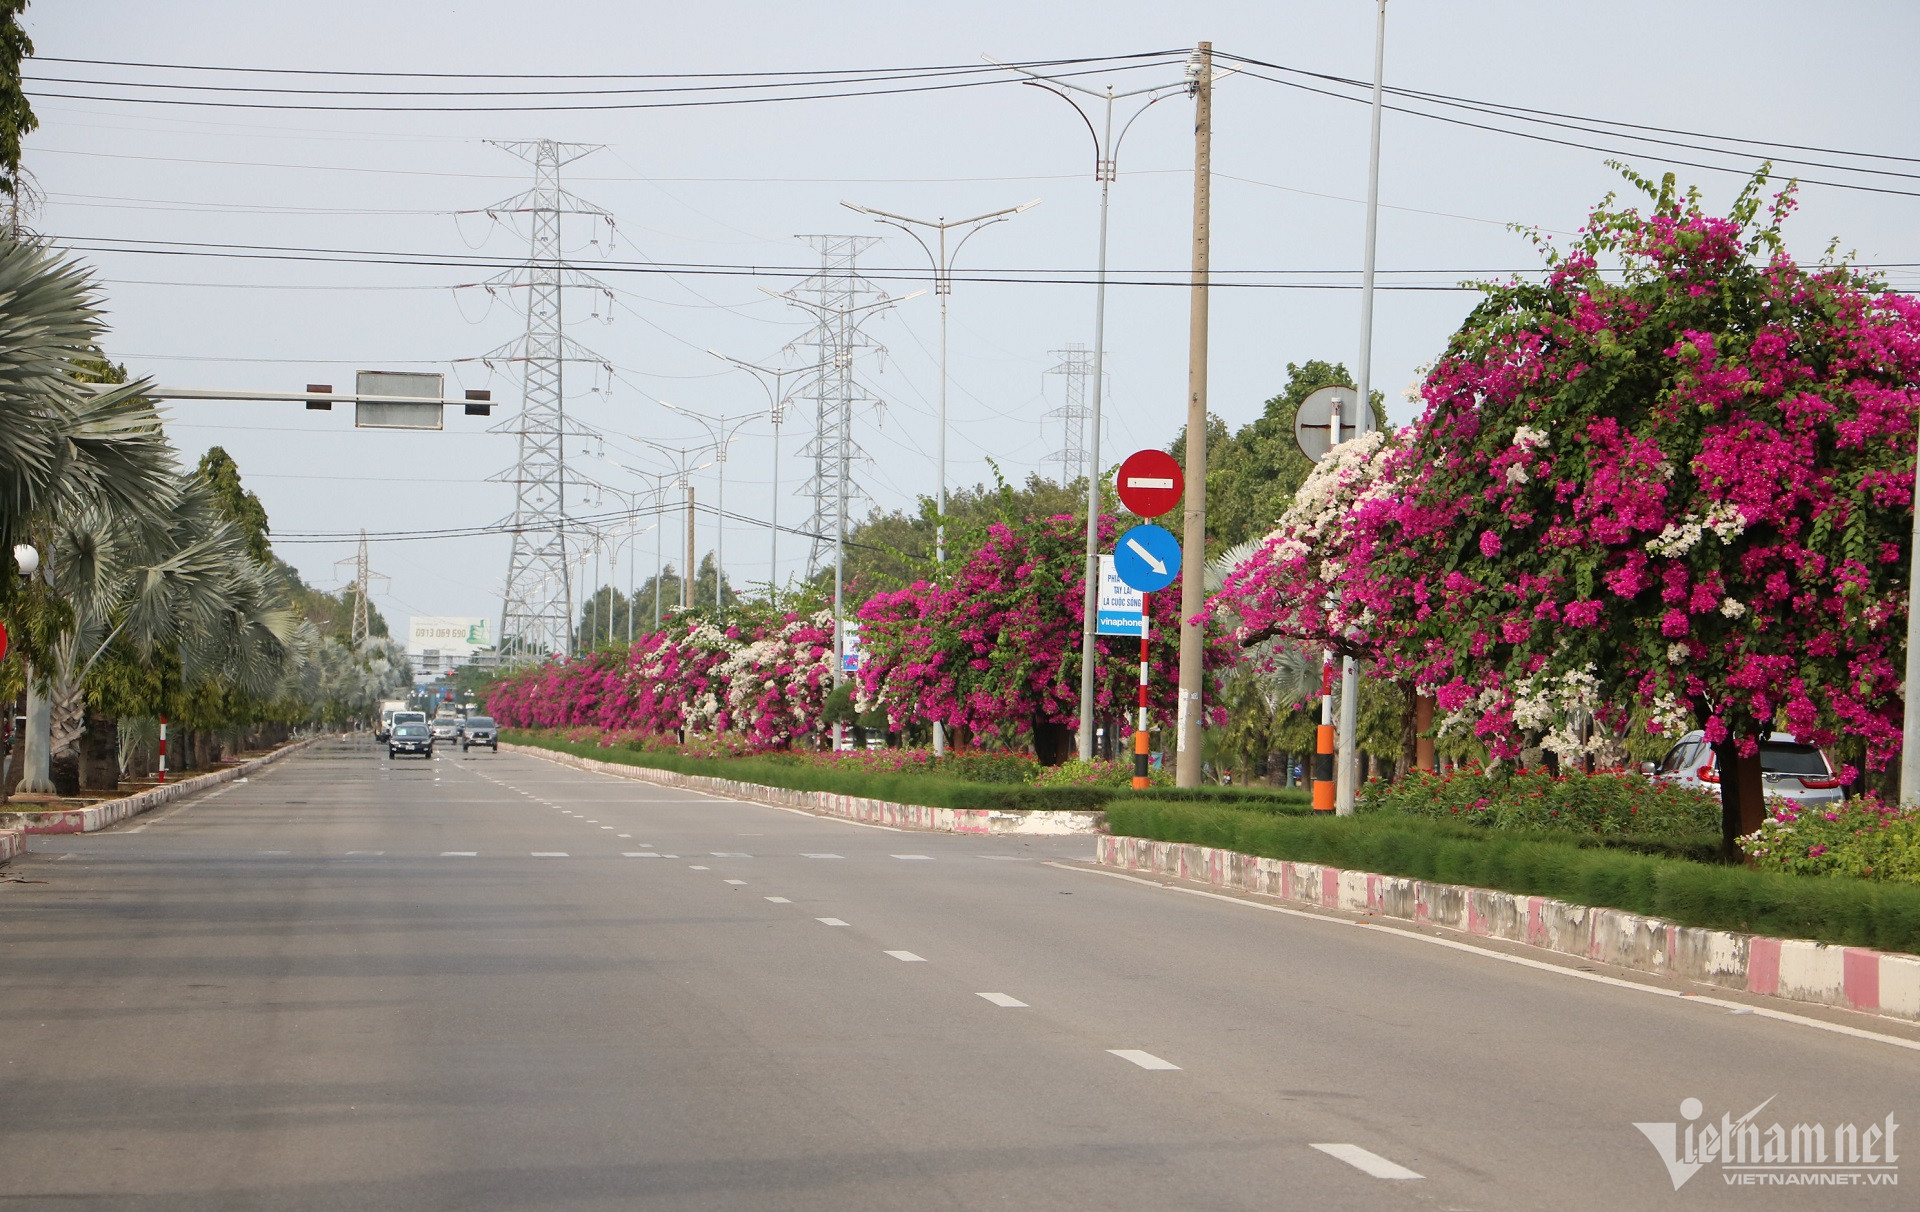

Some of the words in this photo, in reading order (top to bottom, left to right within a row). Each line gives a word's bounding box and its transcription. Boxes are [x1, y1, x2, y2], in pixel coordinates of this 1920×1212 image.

[1114, 586, 1122, 594] TAY
[1100, 617, 1142, 627] vinaphone
[416, 629, 434, 637] 0913
